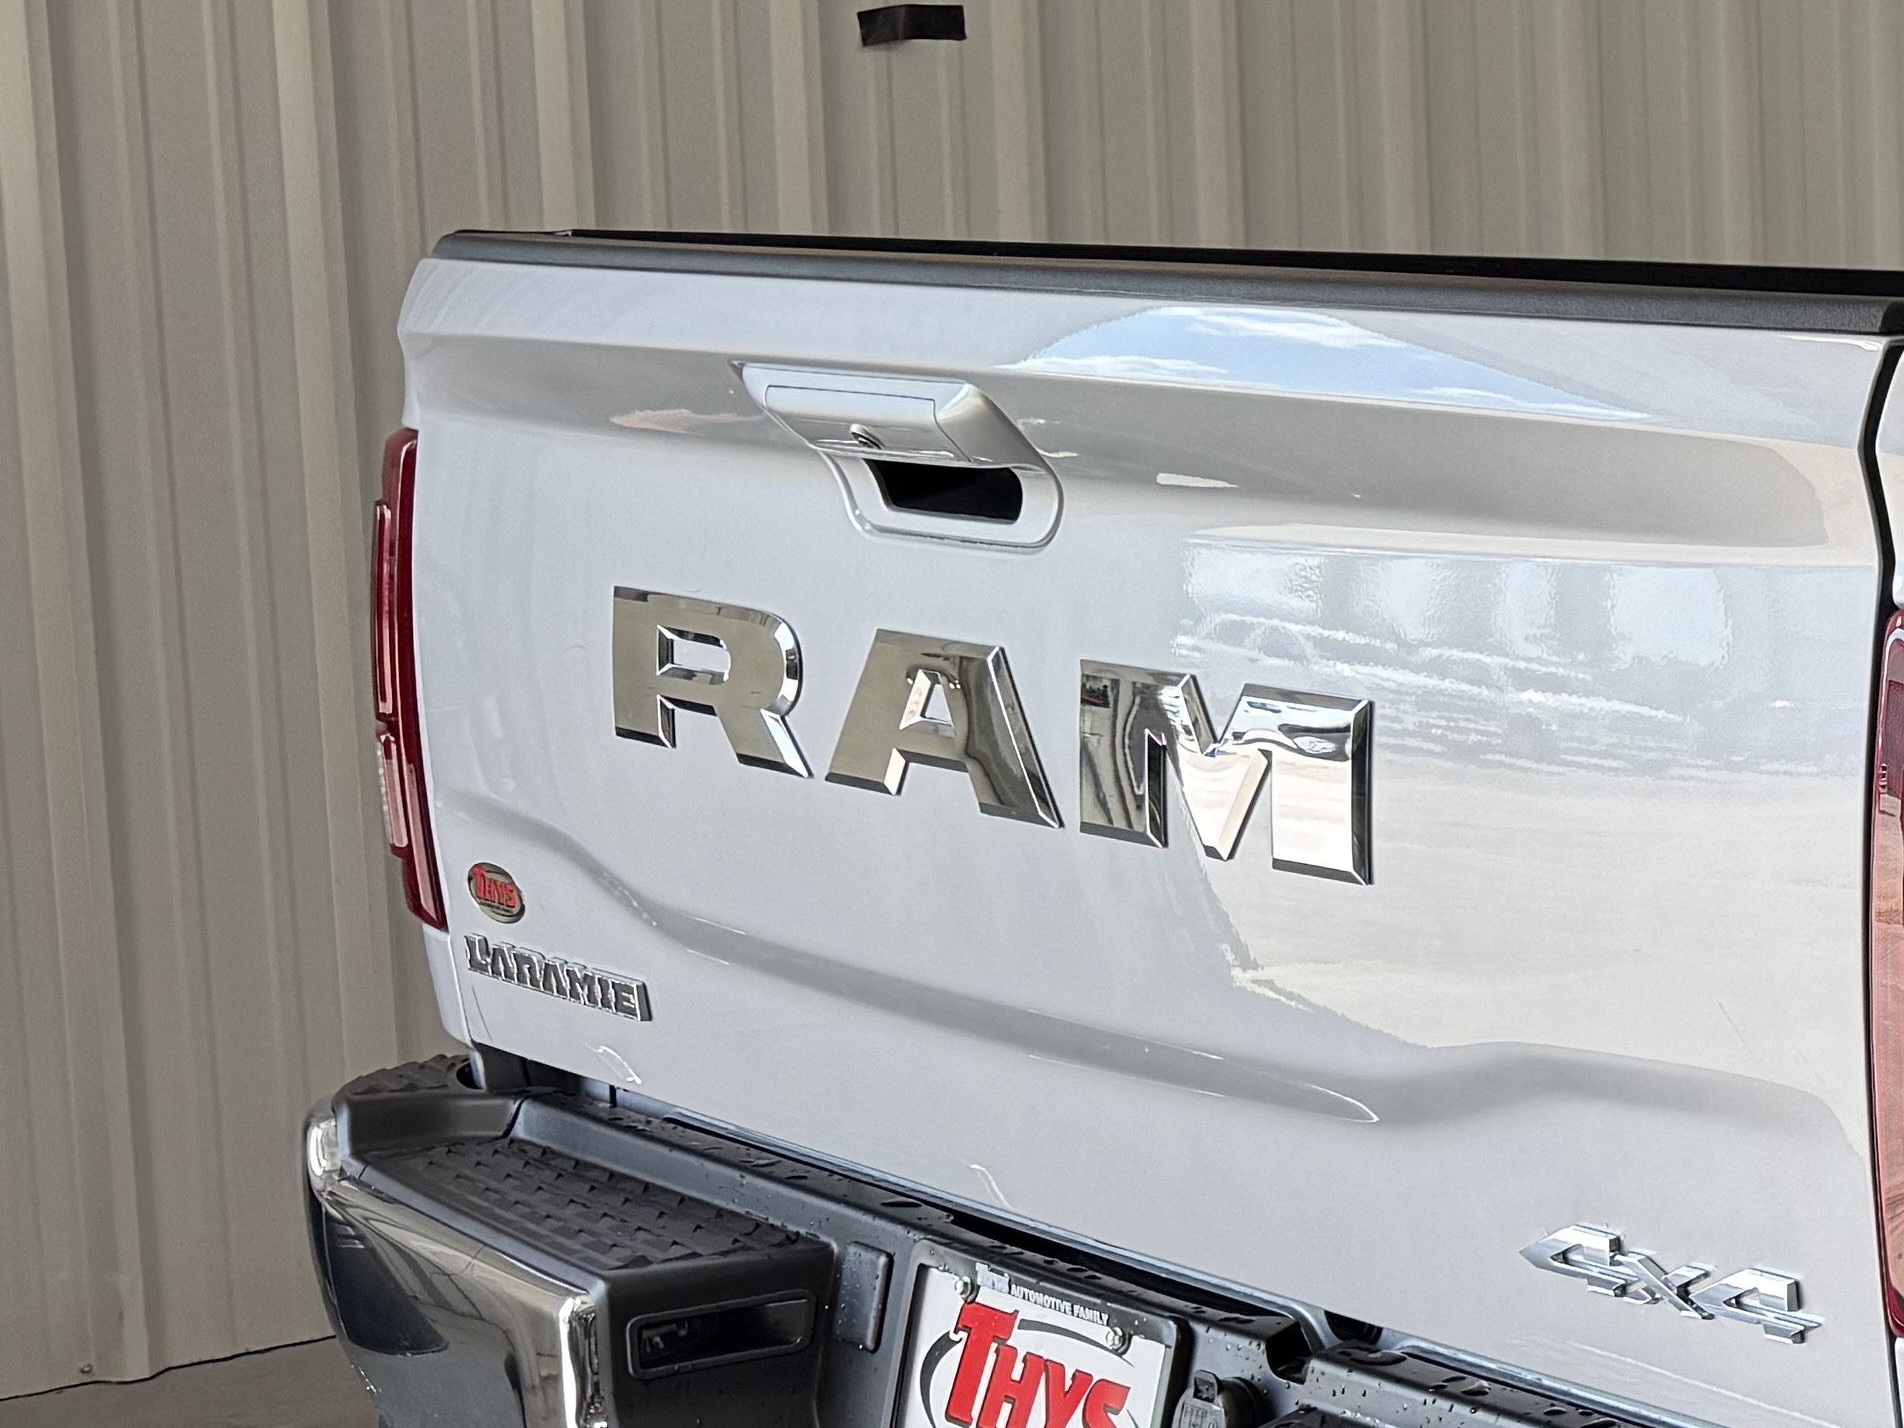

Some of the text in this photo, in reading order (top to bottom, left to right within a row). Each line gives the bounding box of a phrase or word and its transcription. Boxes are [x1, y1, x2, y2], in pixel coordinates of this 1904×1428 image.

[611, 586, 1374, 885] RAM
[472, 865, 517, 908] THYS
[464, 933, 652, 1022] LARAMIE
[1010, 1283, 1110, 1327] AUTOMOTIVE FAMILY
